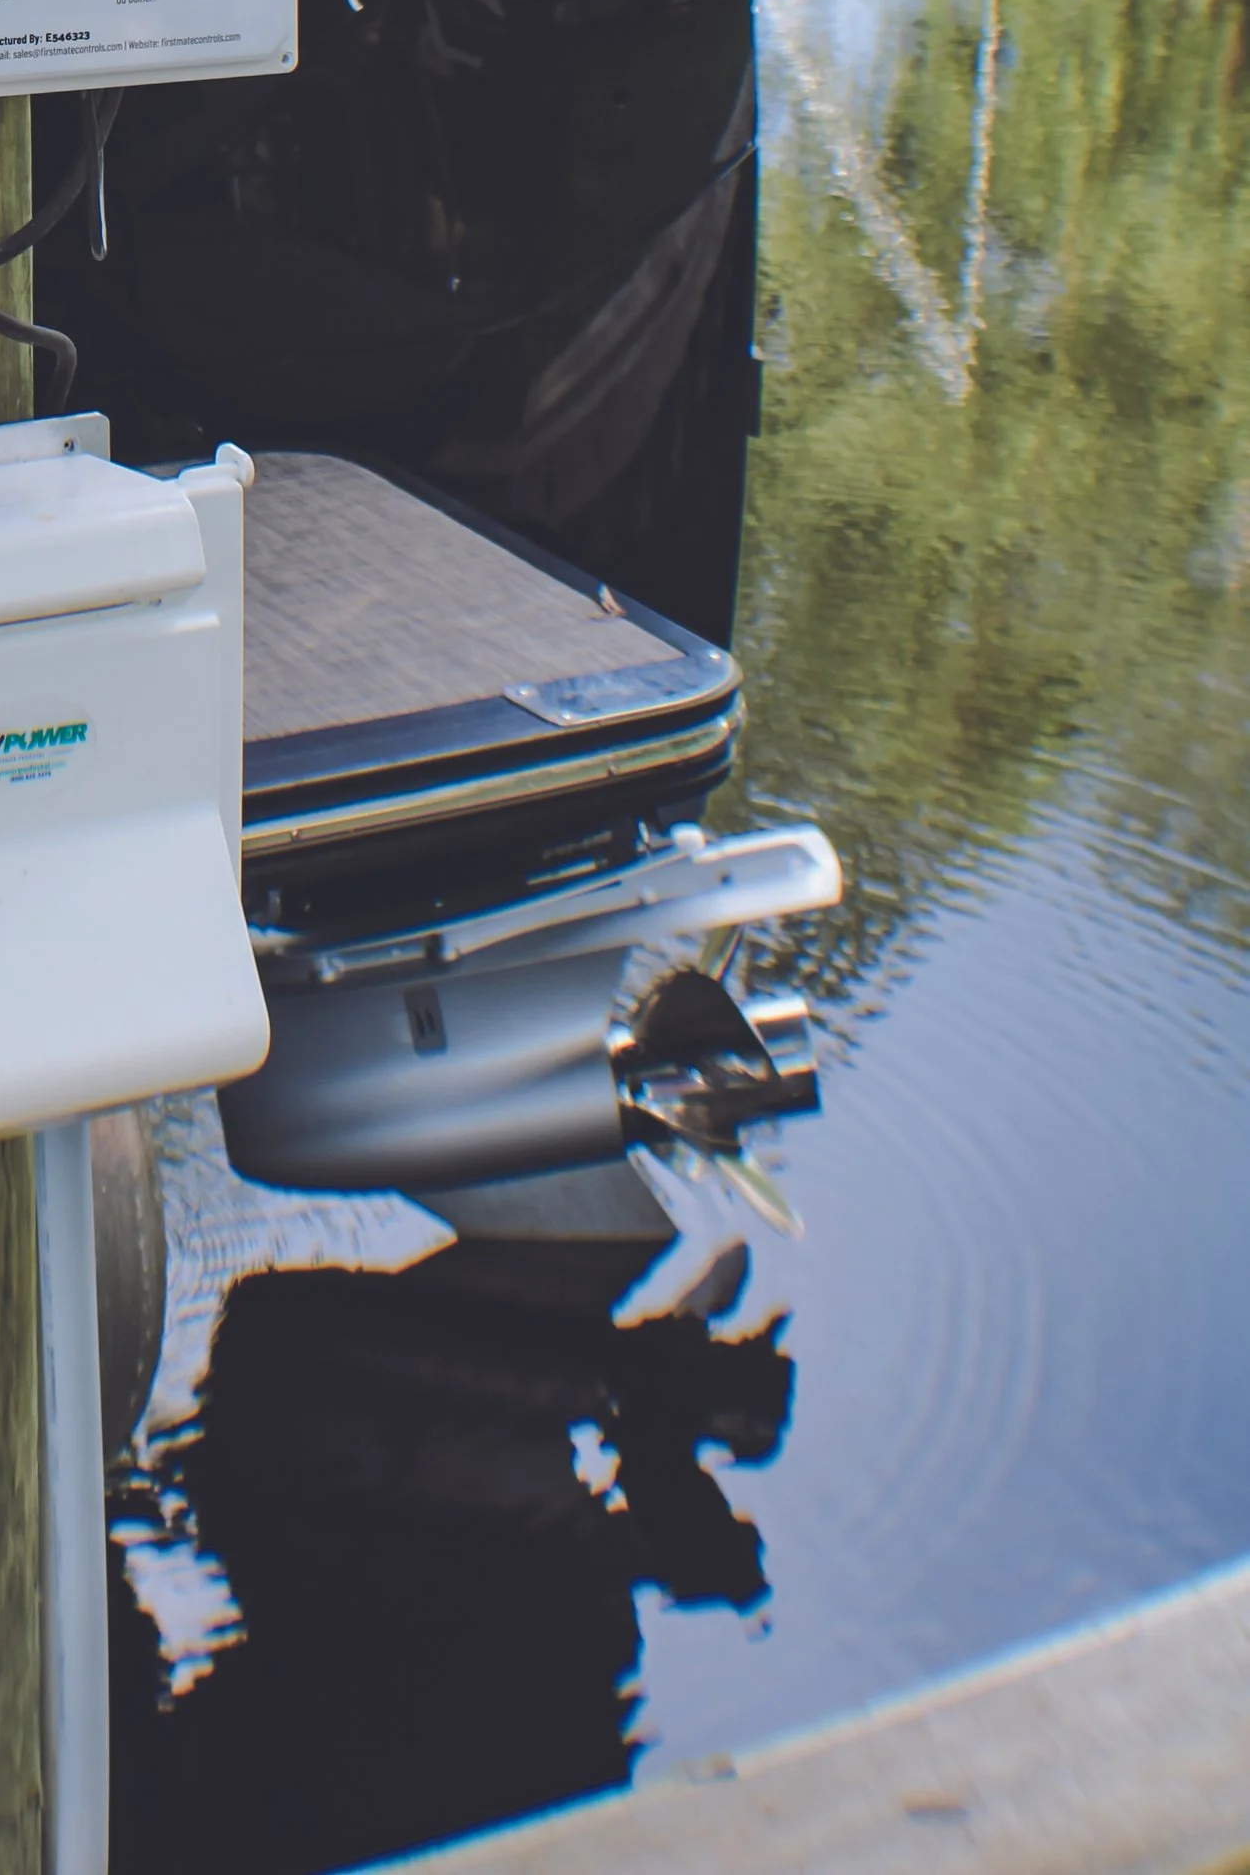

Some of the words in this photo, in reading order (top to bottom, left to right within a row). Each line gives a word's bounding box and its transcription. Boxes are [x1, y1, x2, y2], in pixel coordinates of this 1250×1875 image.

[12, 43, 123, 59] sales@firstmatecontrols.com
[127, 39, 160, 49] Website:
[160, 33, 241, 47] firstmatecontrols.com
[28, 33, 43, 45] By:
[44, 31, 90, 43] E546323
